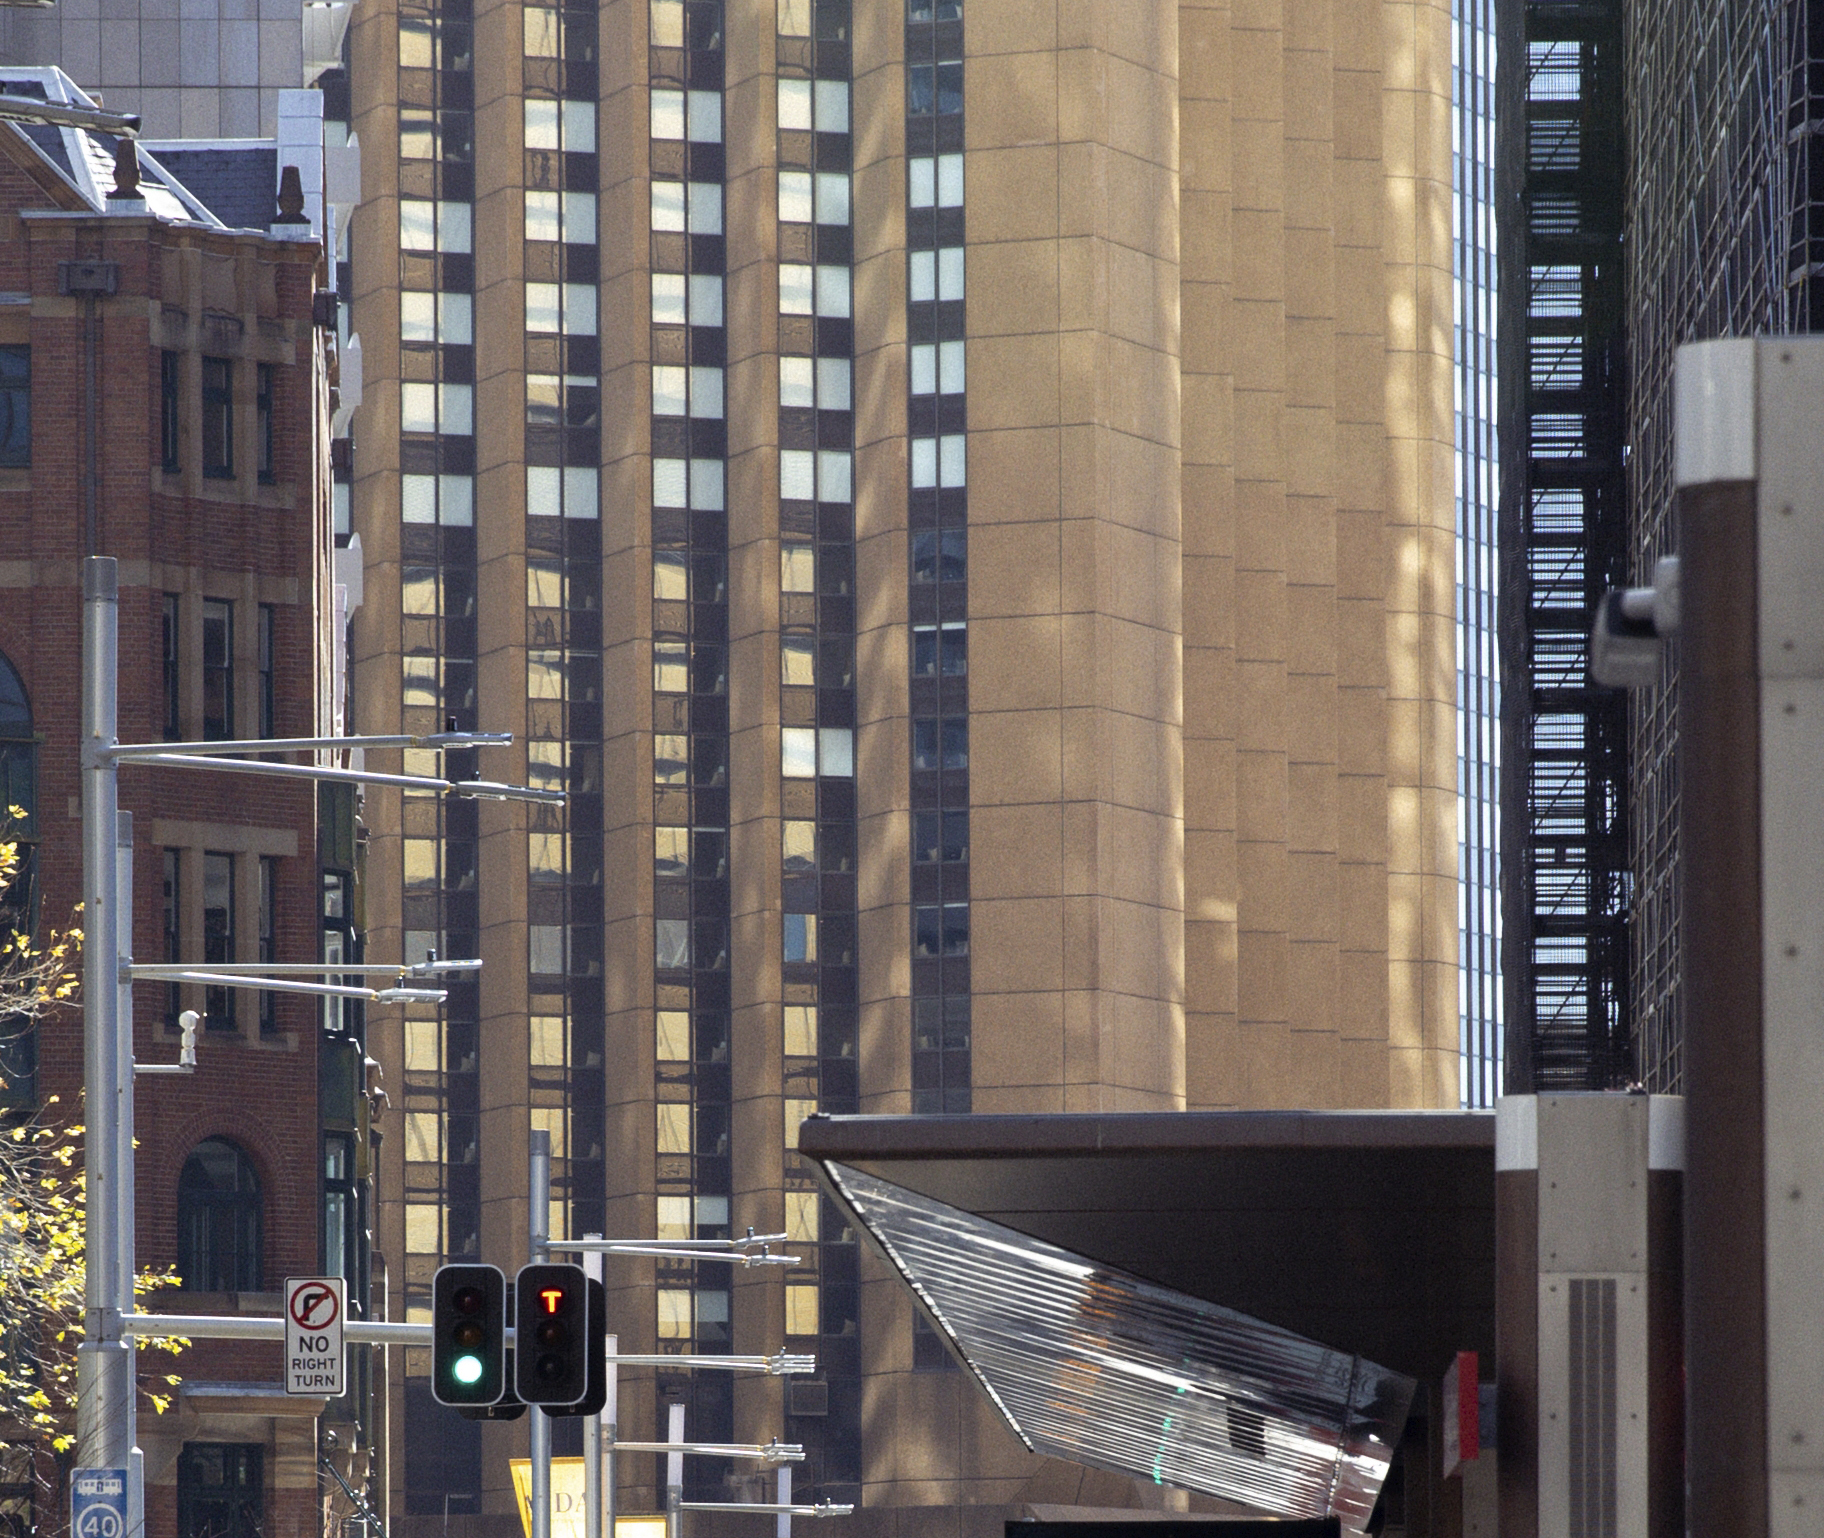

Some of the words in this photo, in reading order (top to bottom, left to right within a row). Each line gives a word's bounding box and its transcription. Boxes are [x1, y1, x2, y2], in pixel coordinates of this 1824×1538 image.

[541, 1290, 563, 1314] T
[299, 1335, 329, 1353] NO
[292, 1358, 337, 1370] RIGHT
[294, 1374, 335, 1387] TURN
[84, 1516, 116, 1538] 40
